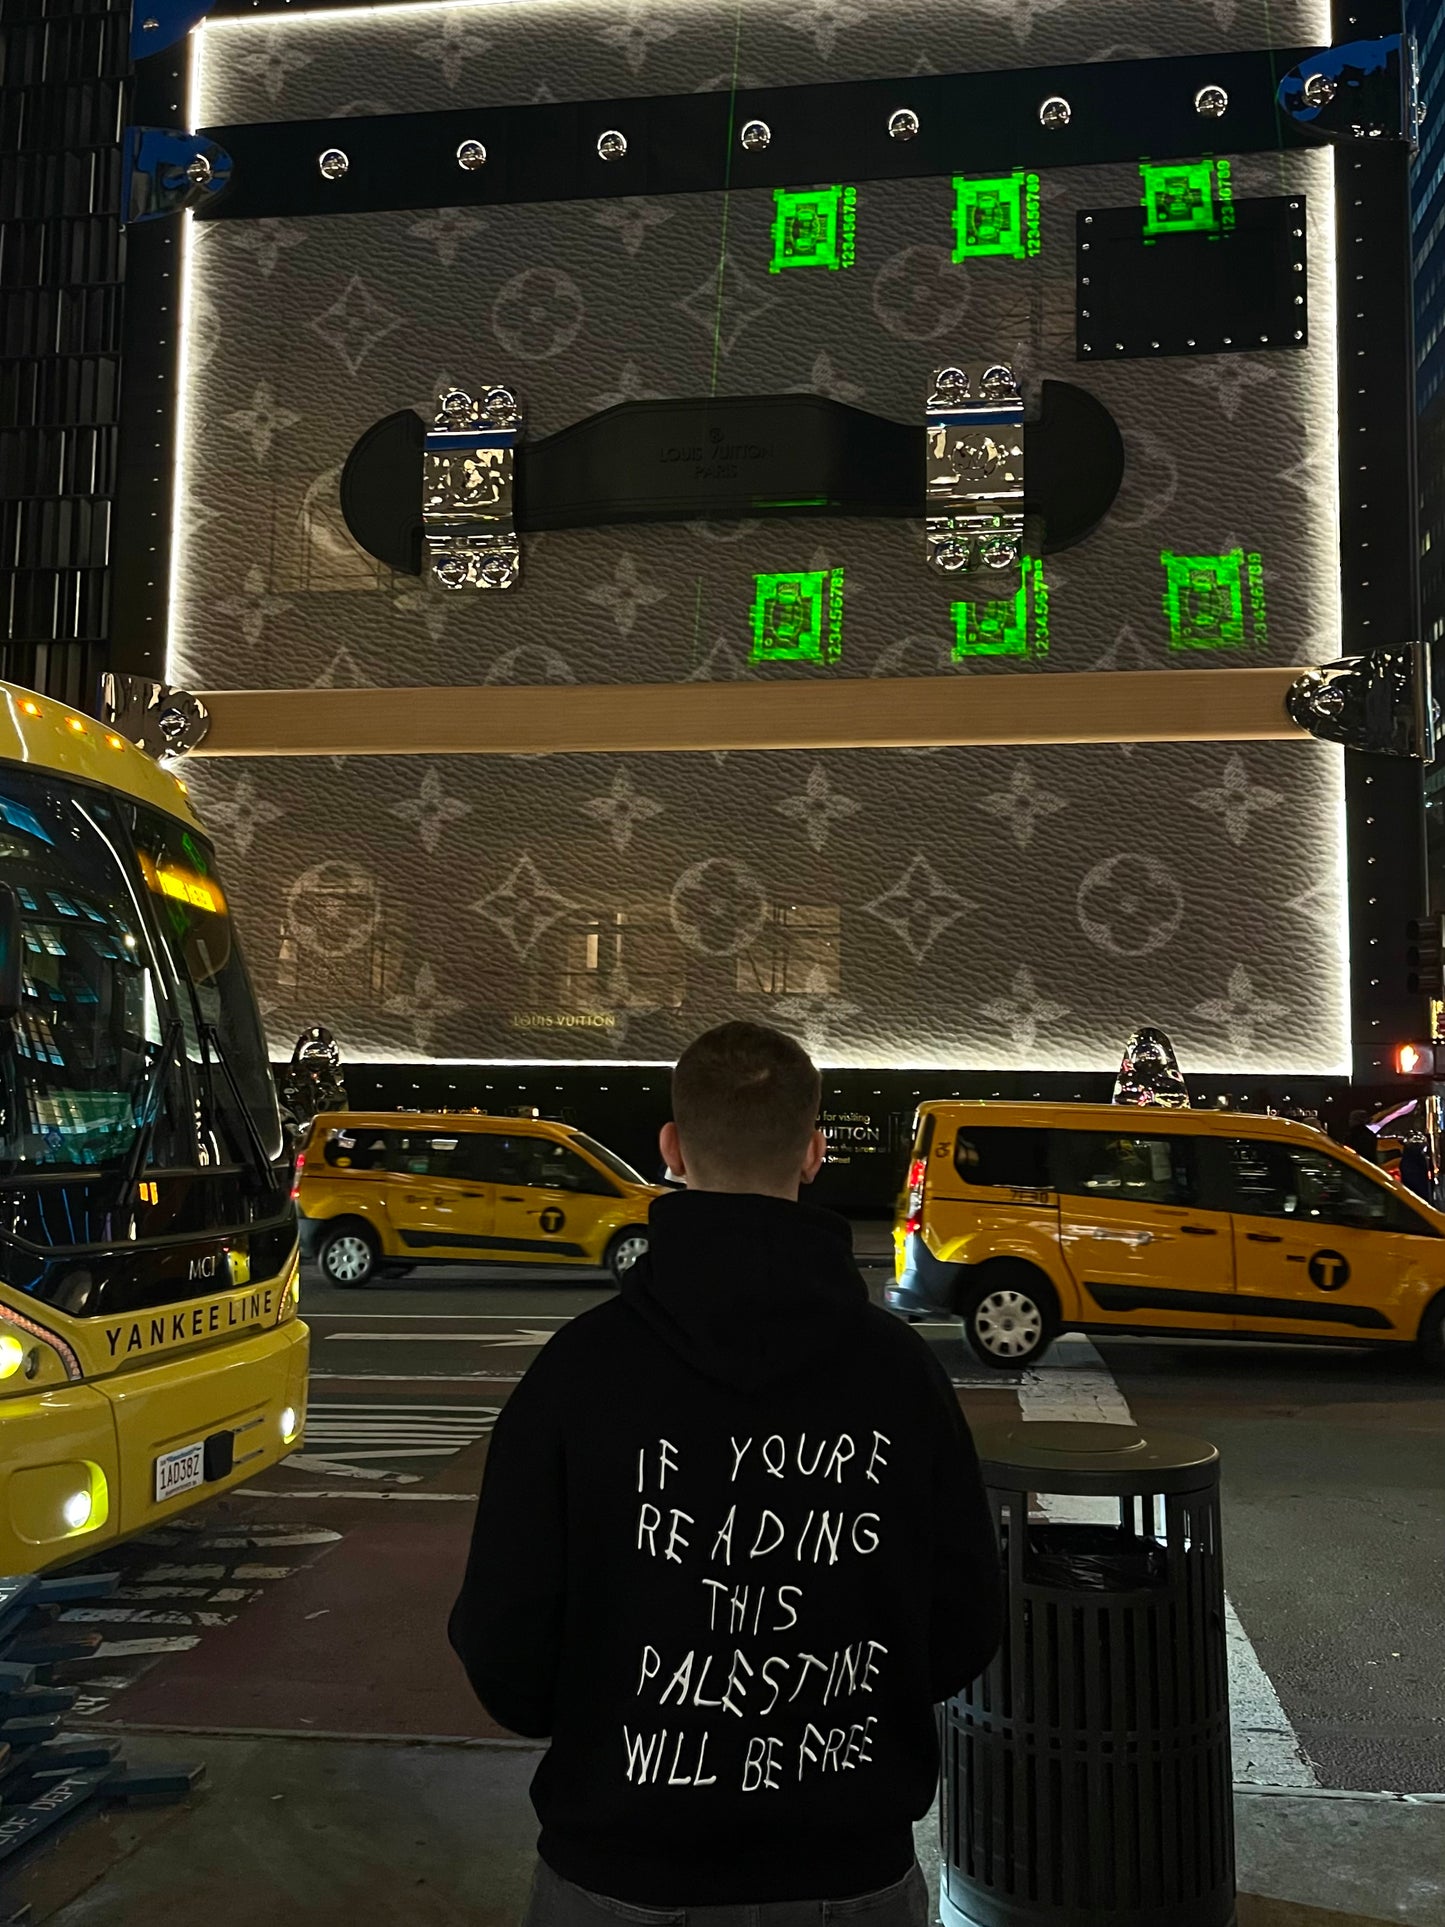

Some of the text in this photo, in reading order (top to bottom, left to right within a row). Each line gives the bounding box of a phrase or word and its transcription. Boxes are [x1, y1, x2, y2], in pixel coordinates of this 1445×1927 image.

[513, 1015, 615, 1027] LOUIS VUITTON
[818, 1126, 880, 1140] UITTON
[188, 1255, 217, 1281] MCI
[105, 1290, 273, 1357] YANKEE LINE
[637, 1438, 679, 1494] IF
[636, 1502, 881, 1566] READING
[702, 1578, 803, 1636] THIS
[636, 1640, 889, 1718] PALESTINE
[623, 1715, 879, 1792] WILL BE FREE
[27, 1778, 89, 1811] DEPT
